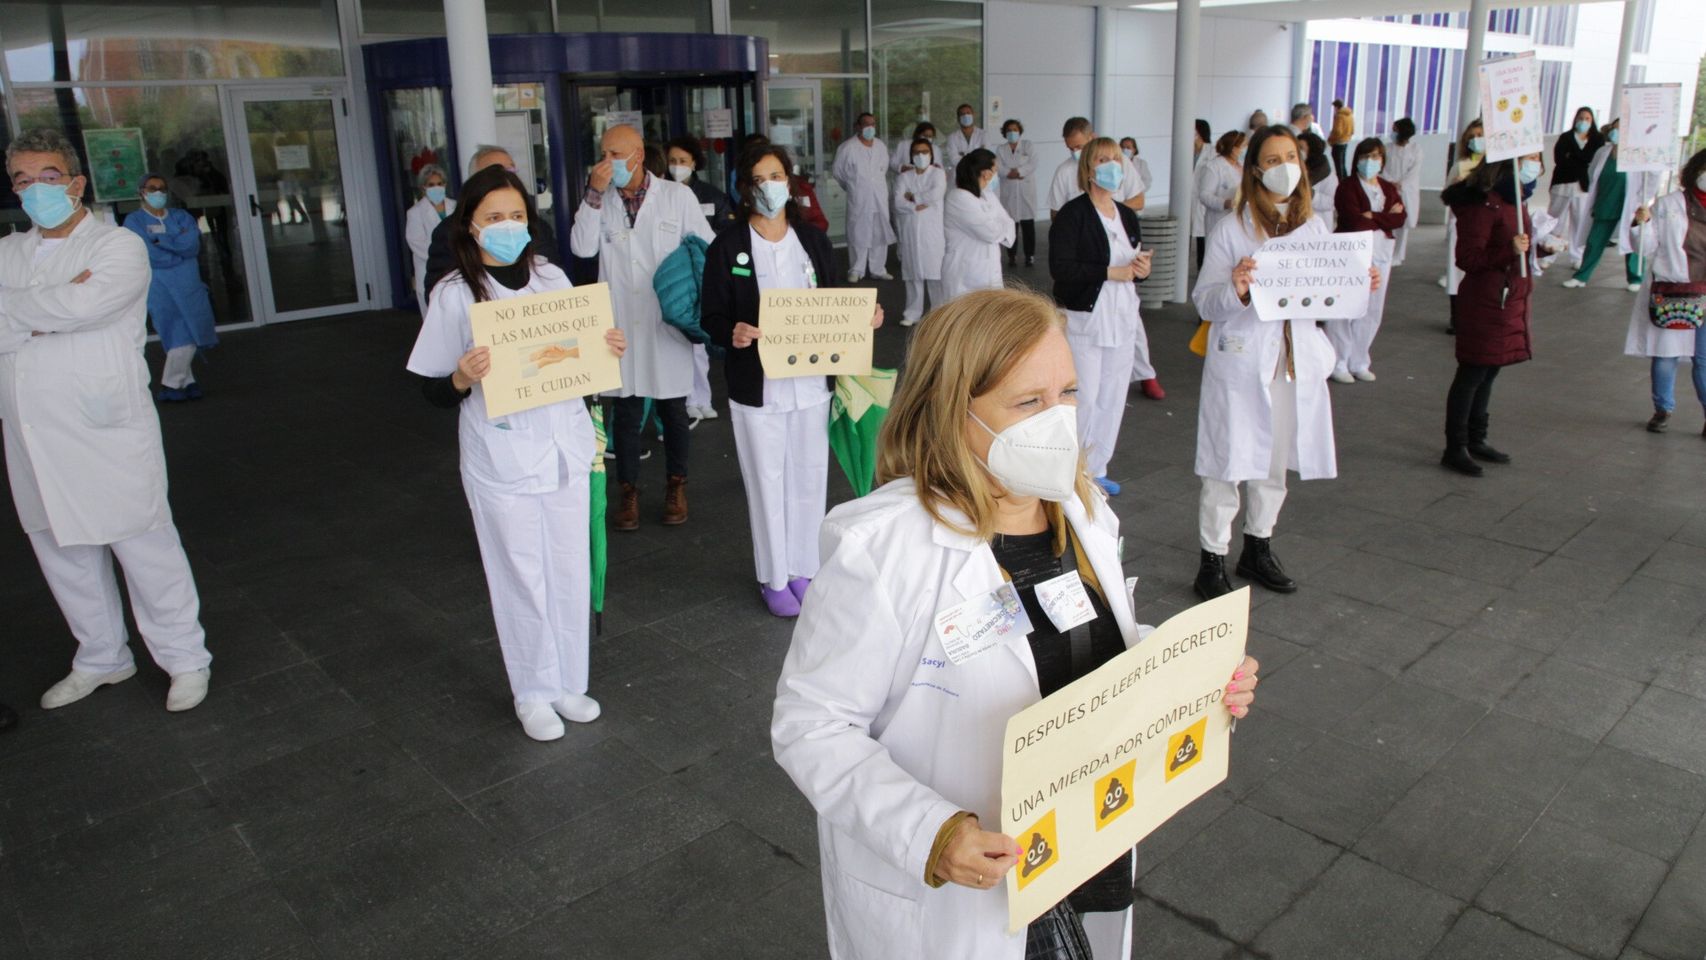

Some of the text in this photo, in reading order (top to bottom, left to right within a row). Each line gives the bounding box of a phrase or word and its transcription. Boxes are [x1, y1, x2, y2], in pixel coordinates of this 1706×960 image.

[1261, 239, 1367, 252] LOS SANITARIOS
[1278, 258, 1348, 269] SE CUIDAN
[1255, 276, 1365, 288] NO SE EXPLOTAN
[768, 296, 868, 308] LOS SANITARIOS
[495, 295, 590, 322] NO RECORTES
[785, 314, 850, 326] SE CUIDAN
[491, 315, 599, 345] LAS MANOS QUE
[764, 333, 867, 345] NO SE EXPLOTAN
[515, 372, 591, 400] TE CUIDAN
[921, 657, 946, 669] Sacyl
[1014, 622, 1234, 754] DESPUES DE LEER EL DECRETO:
[1010, 688, 1223, 824] UNA MIERDA POR COMPLETO
